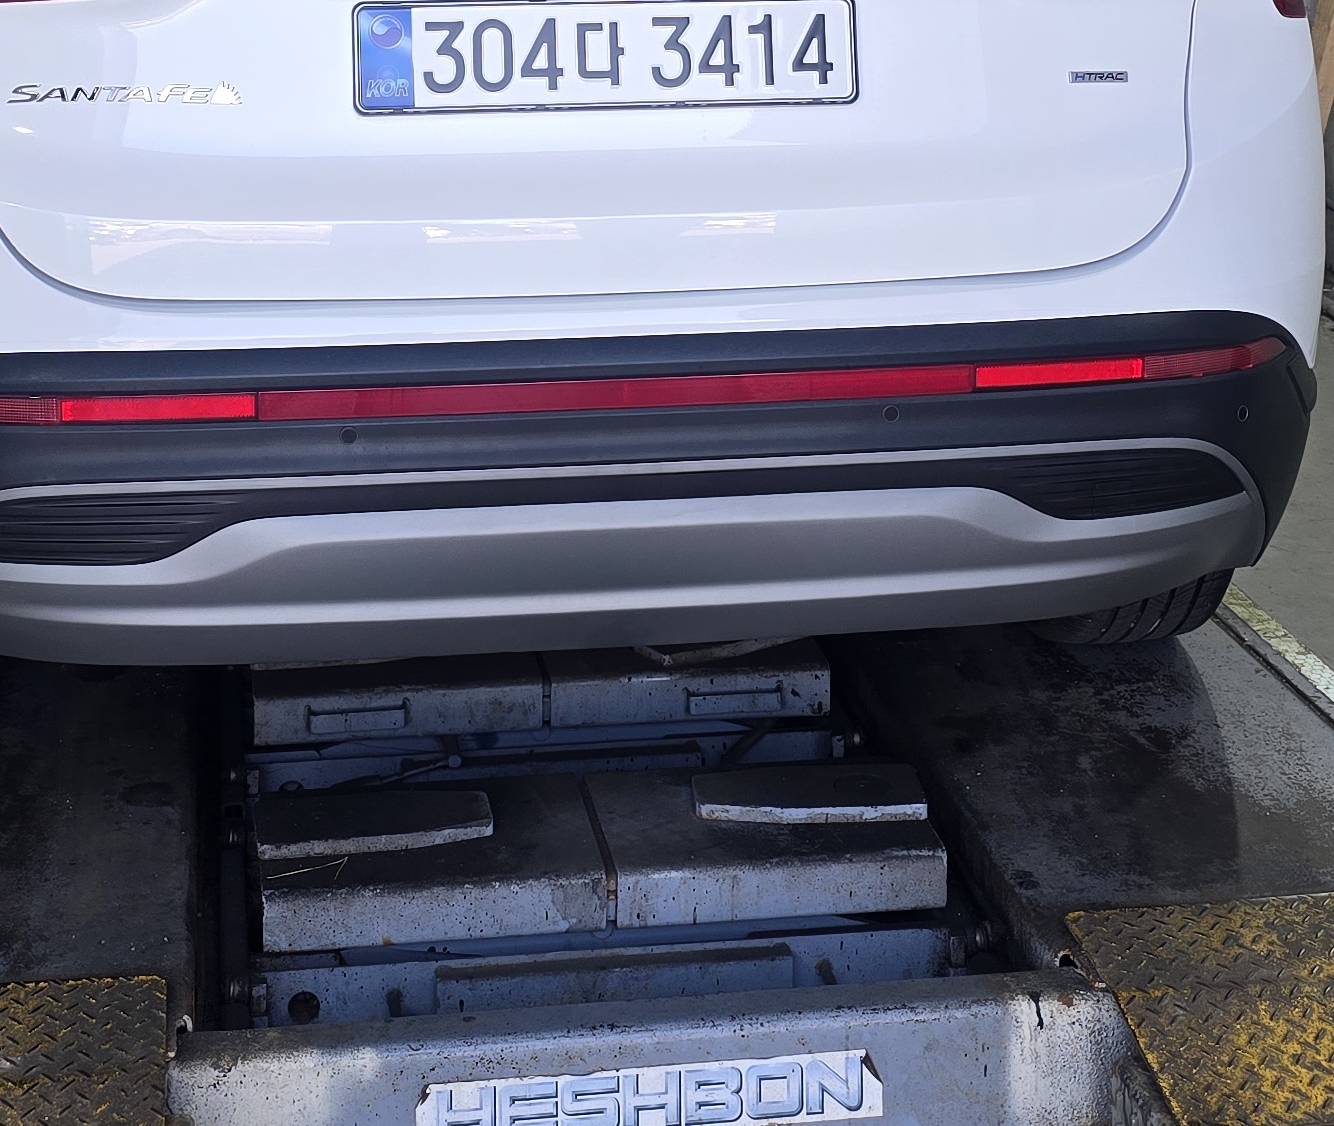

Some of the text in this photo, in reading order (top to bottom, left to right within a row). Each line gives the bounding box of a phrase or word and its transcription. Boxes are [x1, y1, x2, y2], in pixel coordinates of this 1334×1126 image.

[422, 13, 835, 94] 304다 3414
[1075, 72, 1125, 82] HTRAC
[7, 83, 153, 103] SANTA
[365, 78, 410, 98] KOR
[434, 1055, 865, 1126] HESHBON
